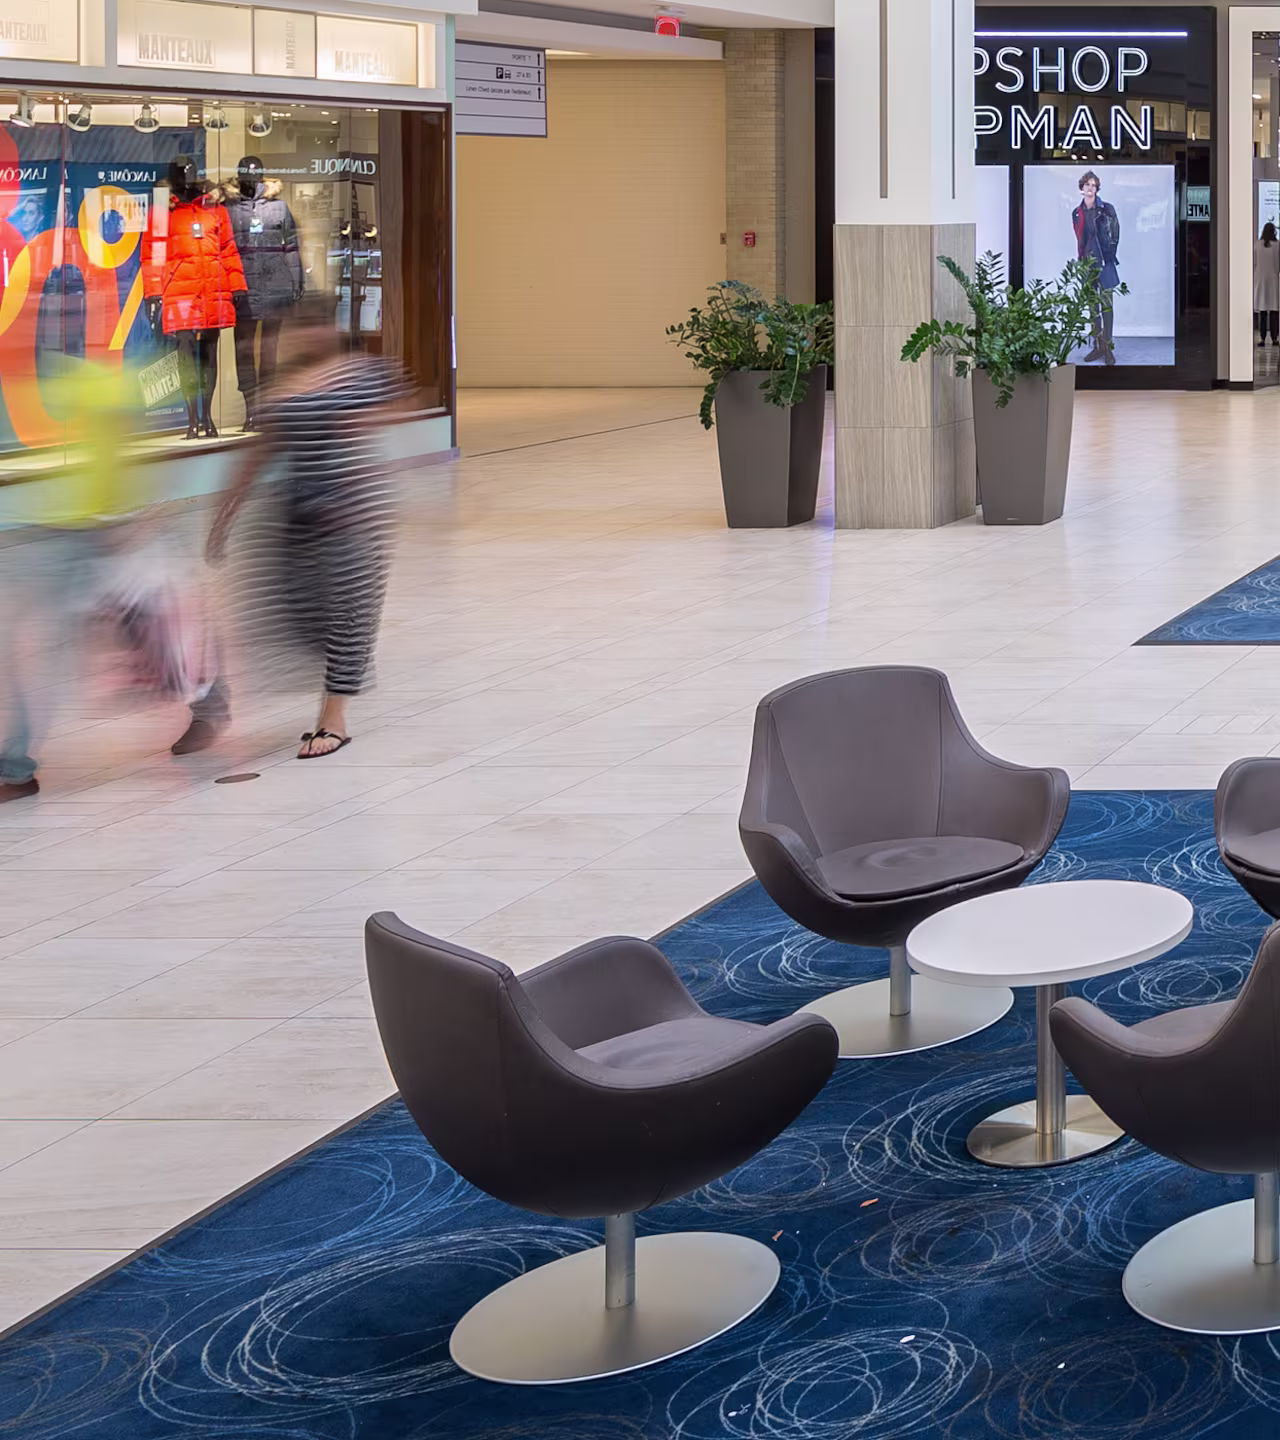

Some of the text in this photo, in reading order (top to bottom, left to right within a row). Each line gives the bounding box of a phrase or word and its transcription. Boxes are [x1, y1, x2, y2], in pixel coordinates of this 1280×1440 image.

[0, 19, 47, 43] ANTEAUX
[138, 32, 213, 65] MANTEAUX
[974, 46, 1149, 93] PSHOP
[974, 105, 1151, 149] PMAN
